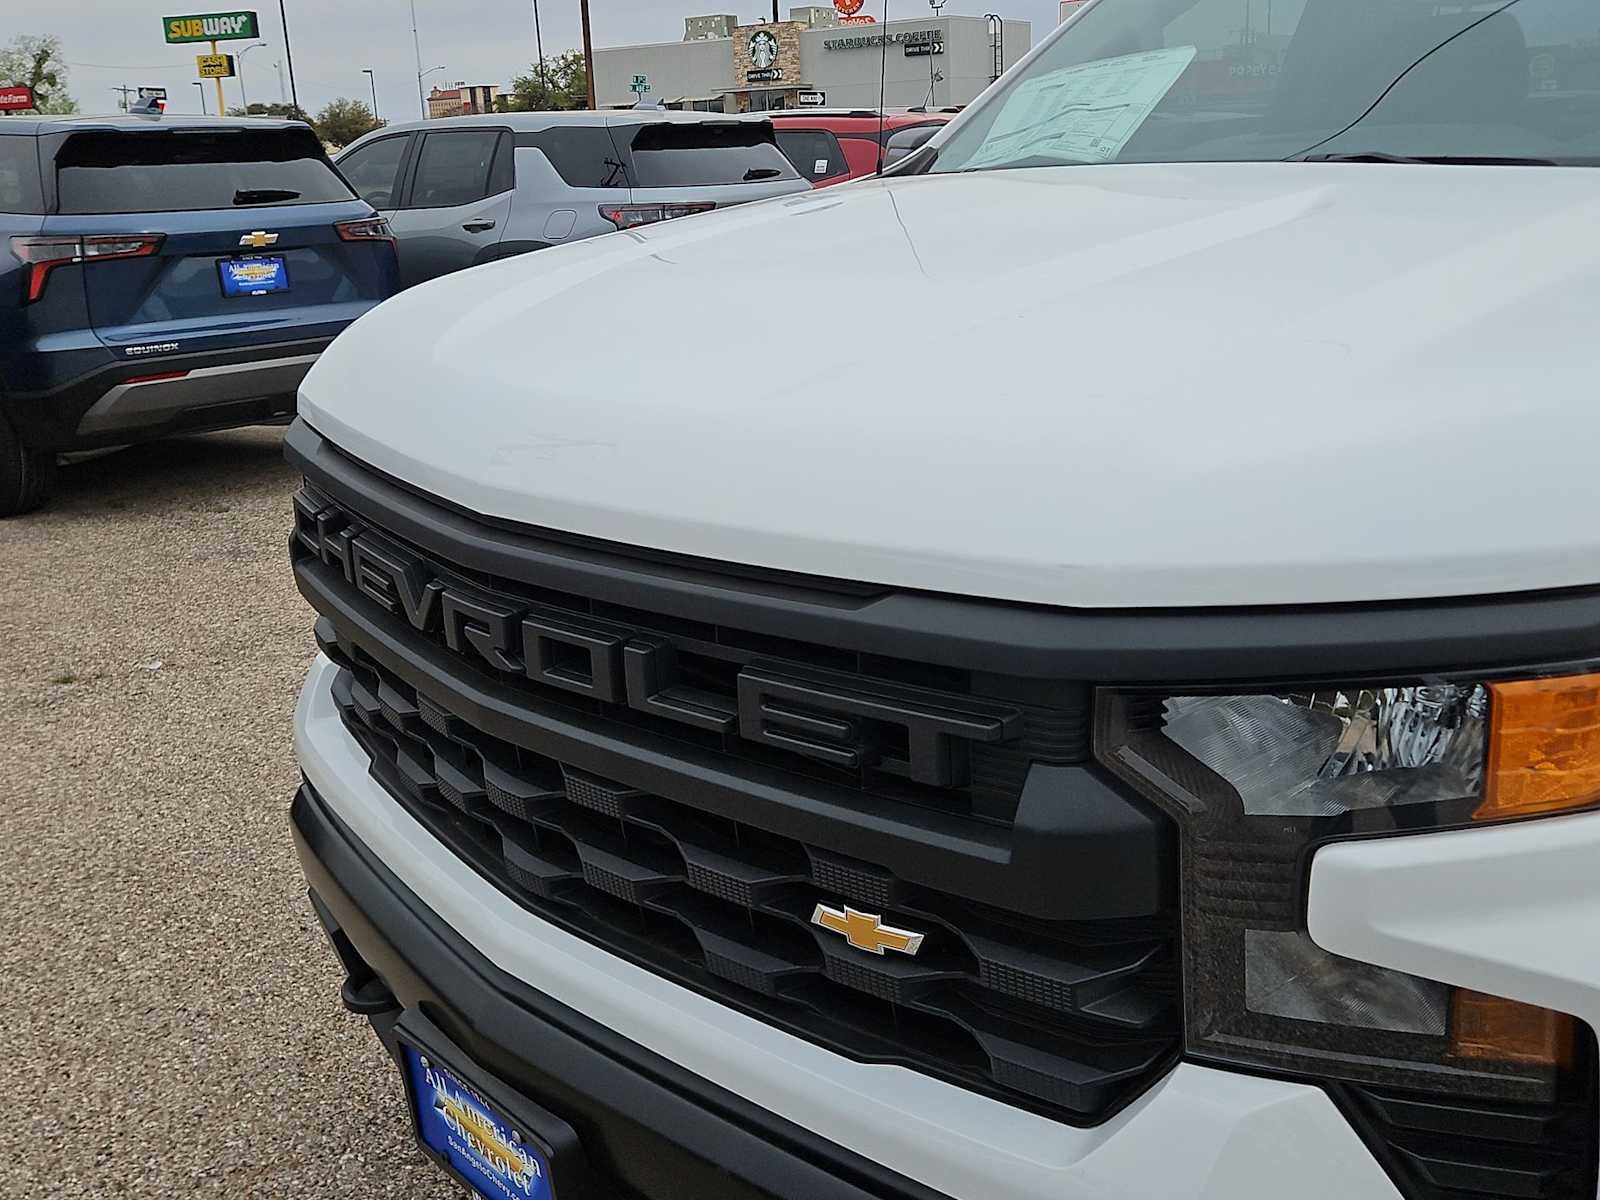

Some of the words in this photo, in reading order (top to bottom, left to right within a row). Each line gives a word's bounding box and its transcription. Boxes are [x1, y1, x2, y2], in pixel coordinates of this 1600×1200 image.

[168, 14, 247, 39] SUBWAY
[823, 34, 892, 50] STARBUCKS
[895, 30, 942, 44] COFFEE
[199, 65, 228, 75] STORE
[125, 342, 179, 355] EQUINOX
[293, 488, 1010, 787] CHEVROLET
[425, 1067, 447, 1095] All
[454, 1090, 542, 1178] American
[443, 1106, 531, 1196] Chevrolet
